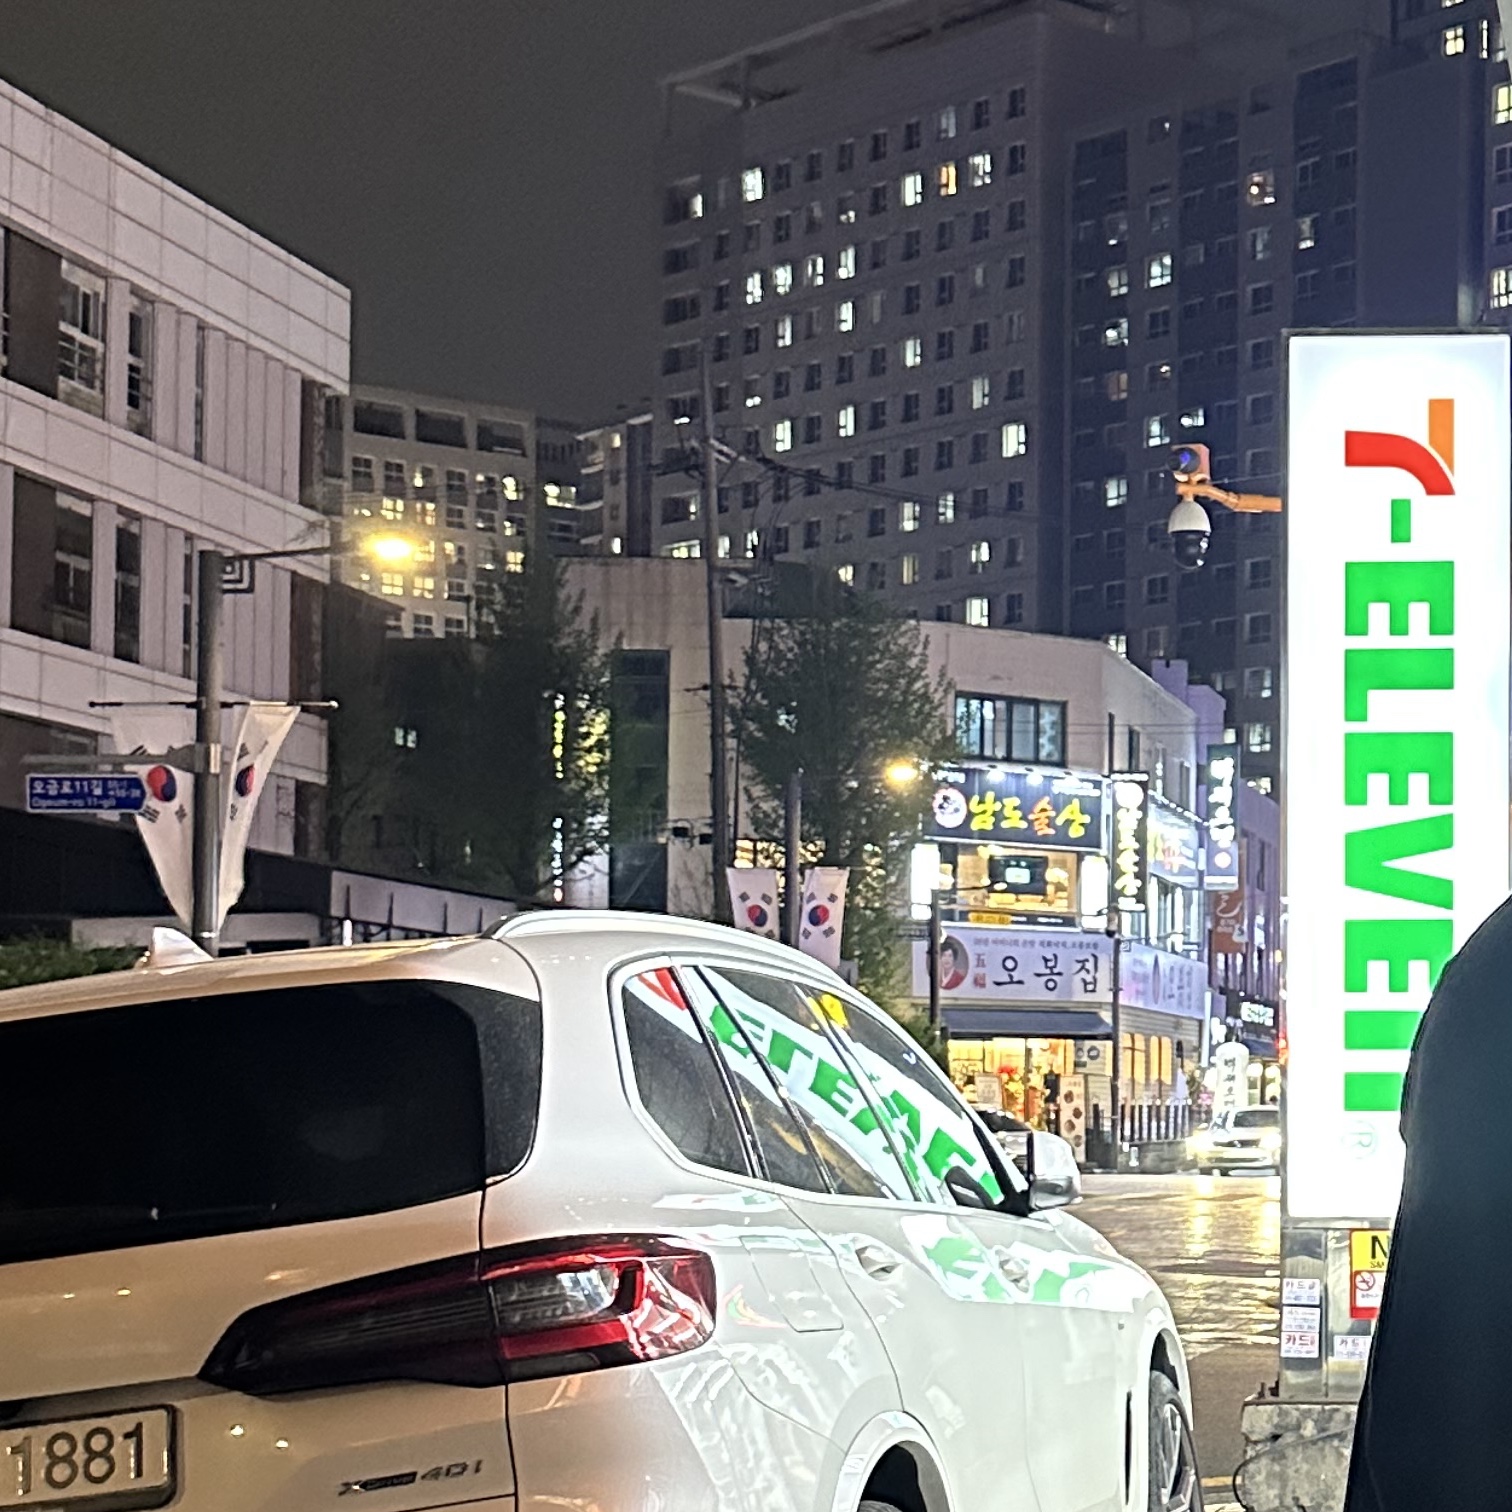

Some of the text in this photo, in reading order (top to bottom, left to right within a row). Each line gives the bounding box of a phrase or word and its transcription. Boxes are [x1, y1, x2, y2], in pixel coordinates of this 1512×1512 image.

[32, 779, 103, 796] 오금로11길
[969, 791, 1091, 839] 남도술상
[993, 952, 1100, 993] 오봉집
[6, 1422, 144, 1497] 1881
